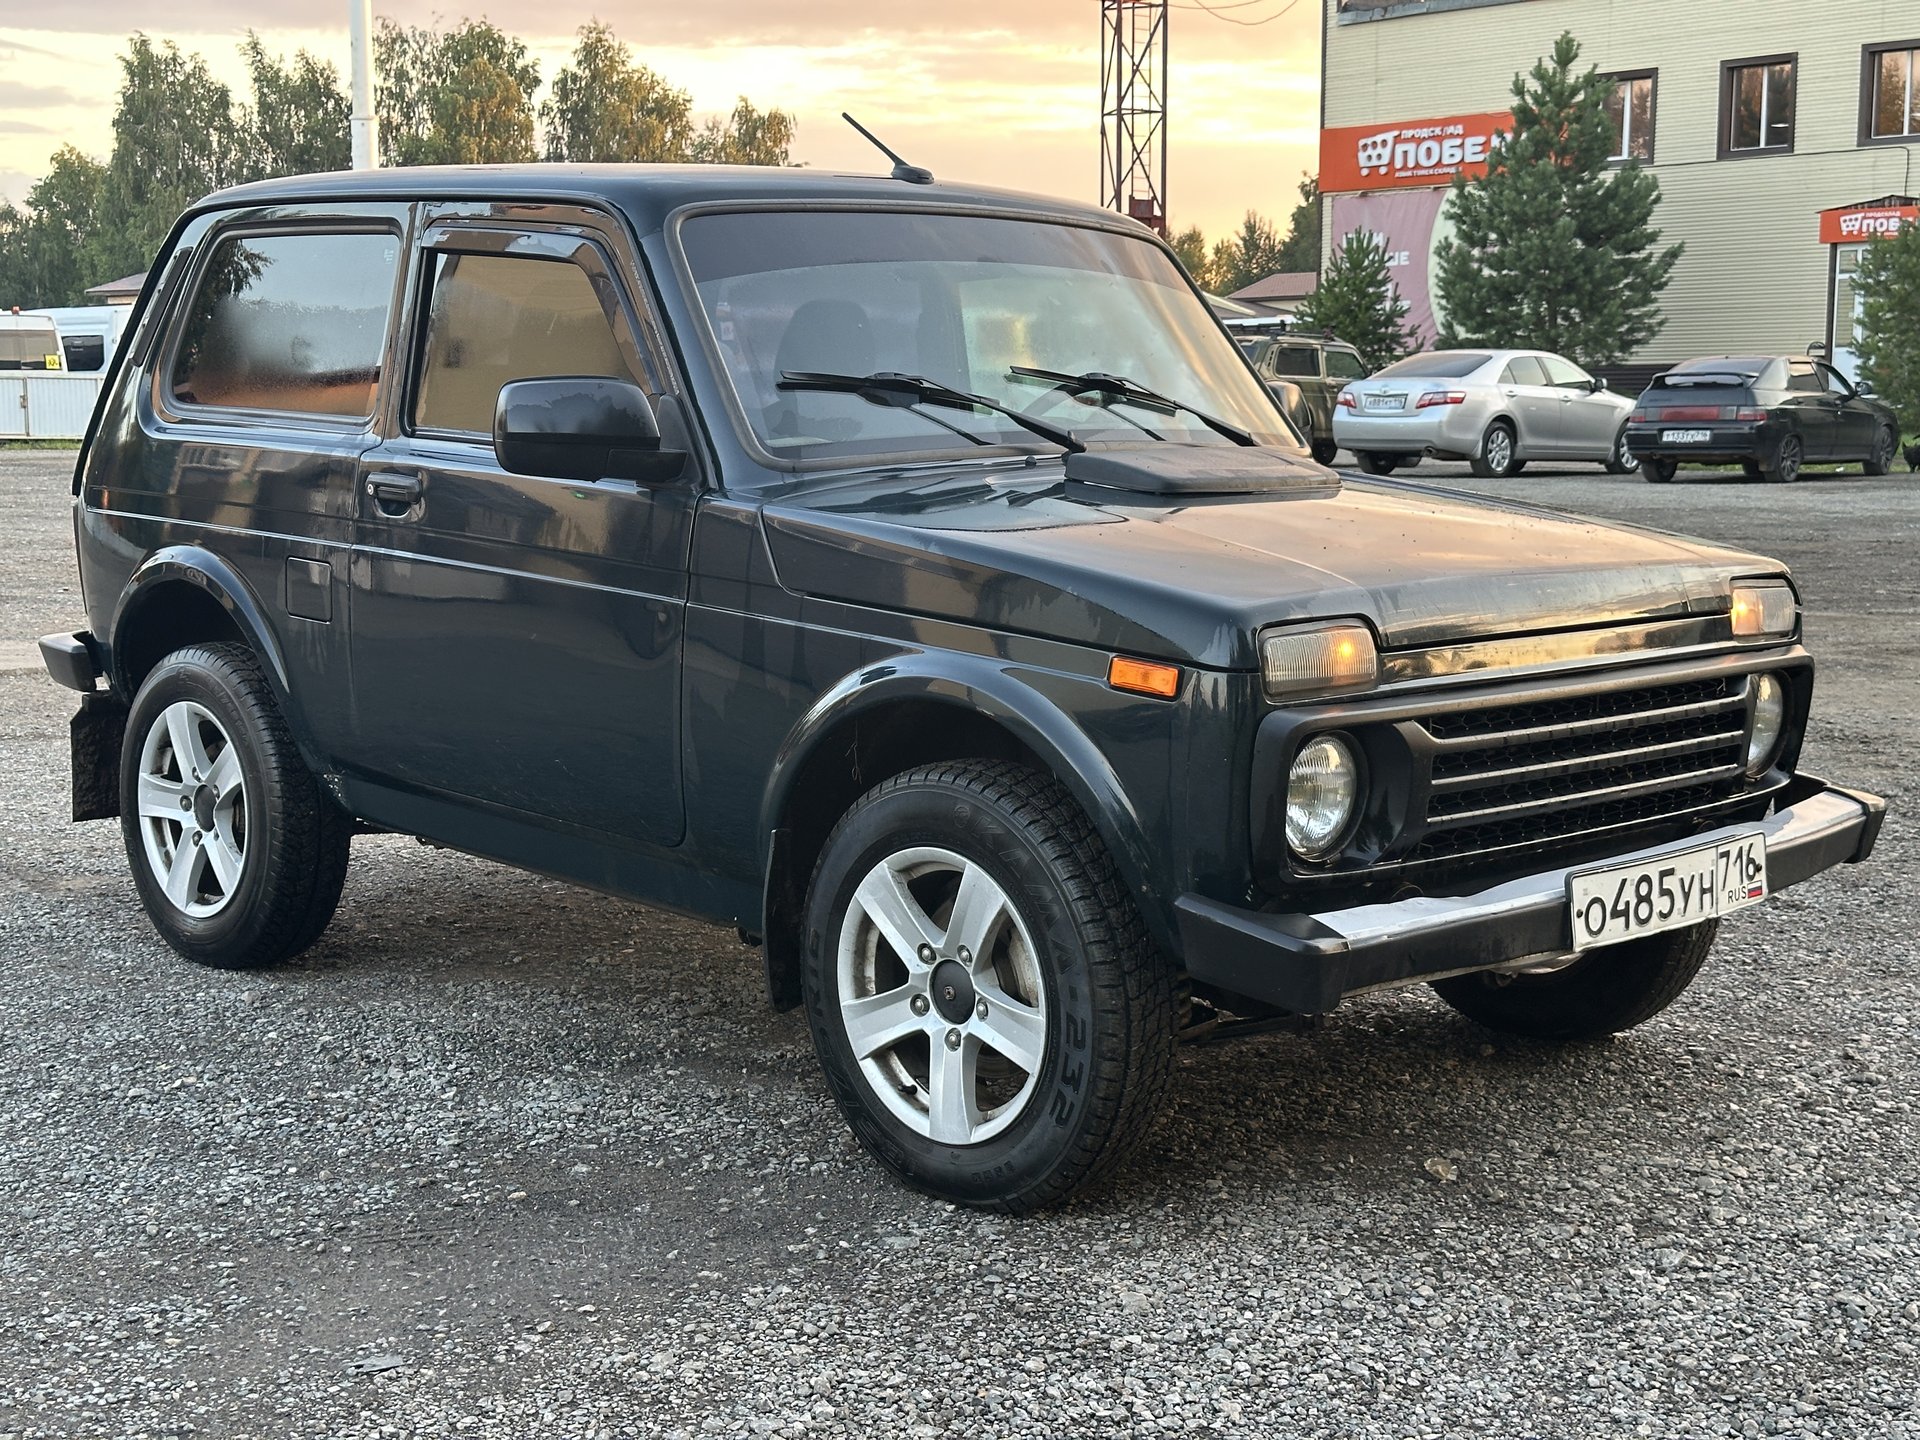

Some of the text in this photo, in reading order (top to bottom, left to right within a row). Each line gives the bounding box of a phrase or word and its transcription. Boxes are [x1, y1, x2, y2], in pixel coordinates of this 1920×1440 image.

[1584, 842, 1757, 938] О485УН 716
[1727, 884, 1748, 904] RUS
